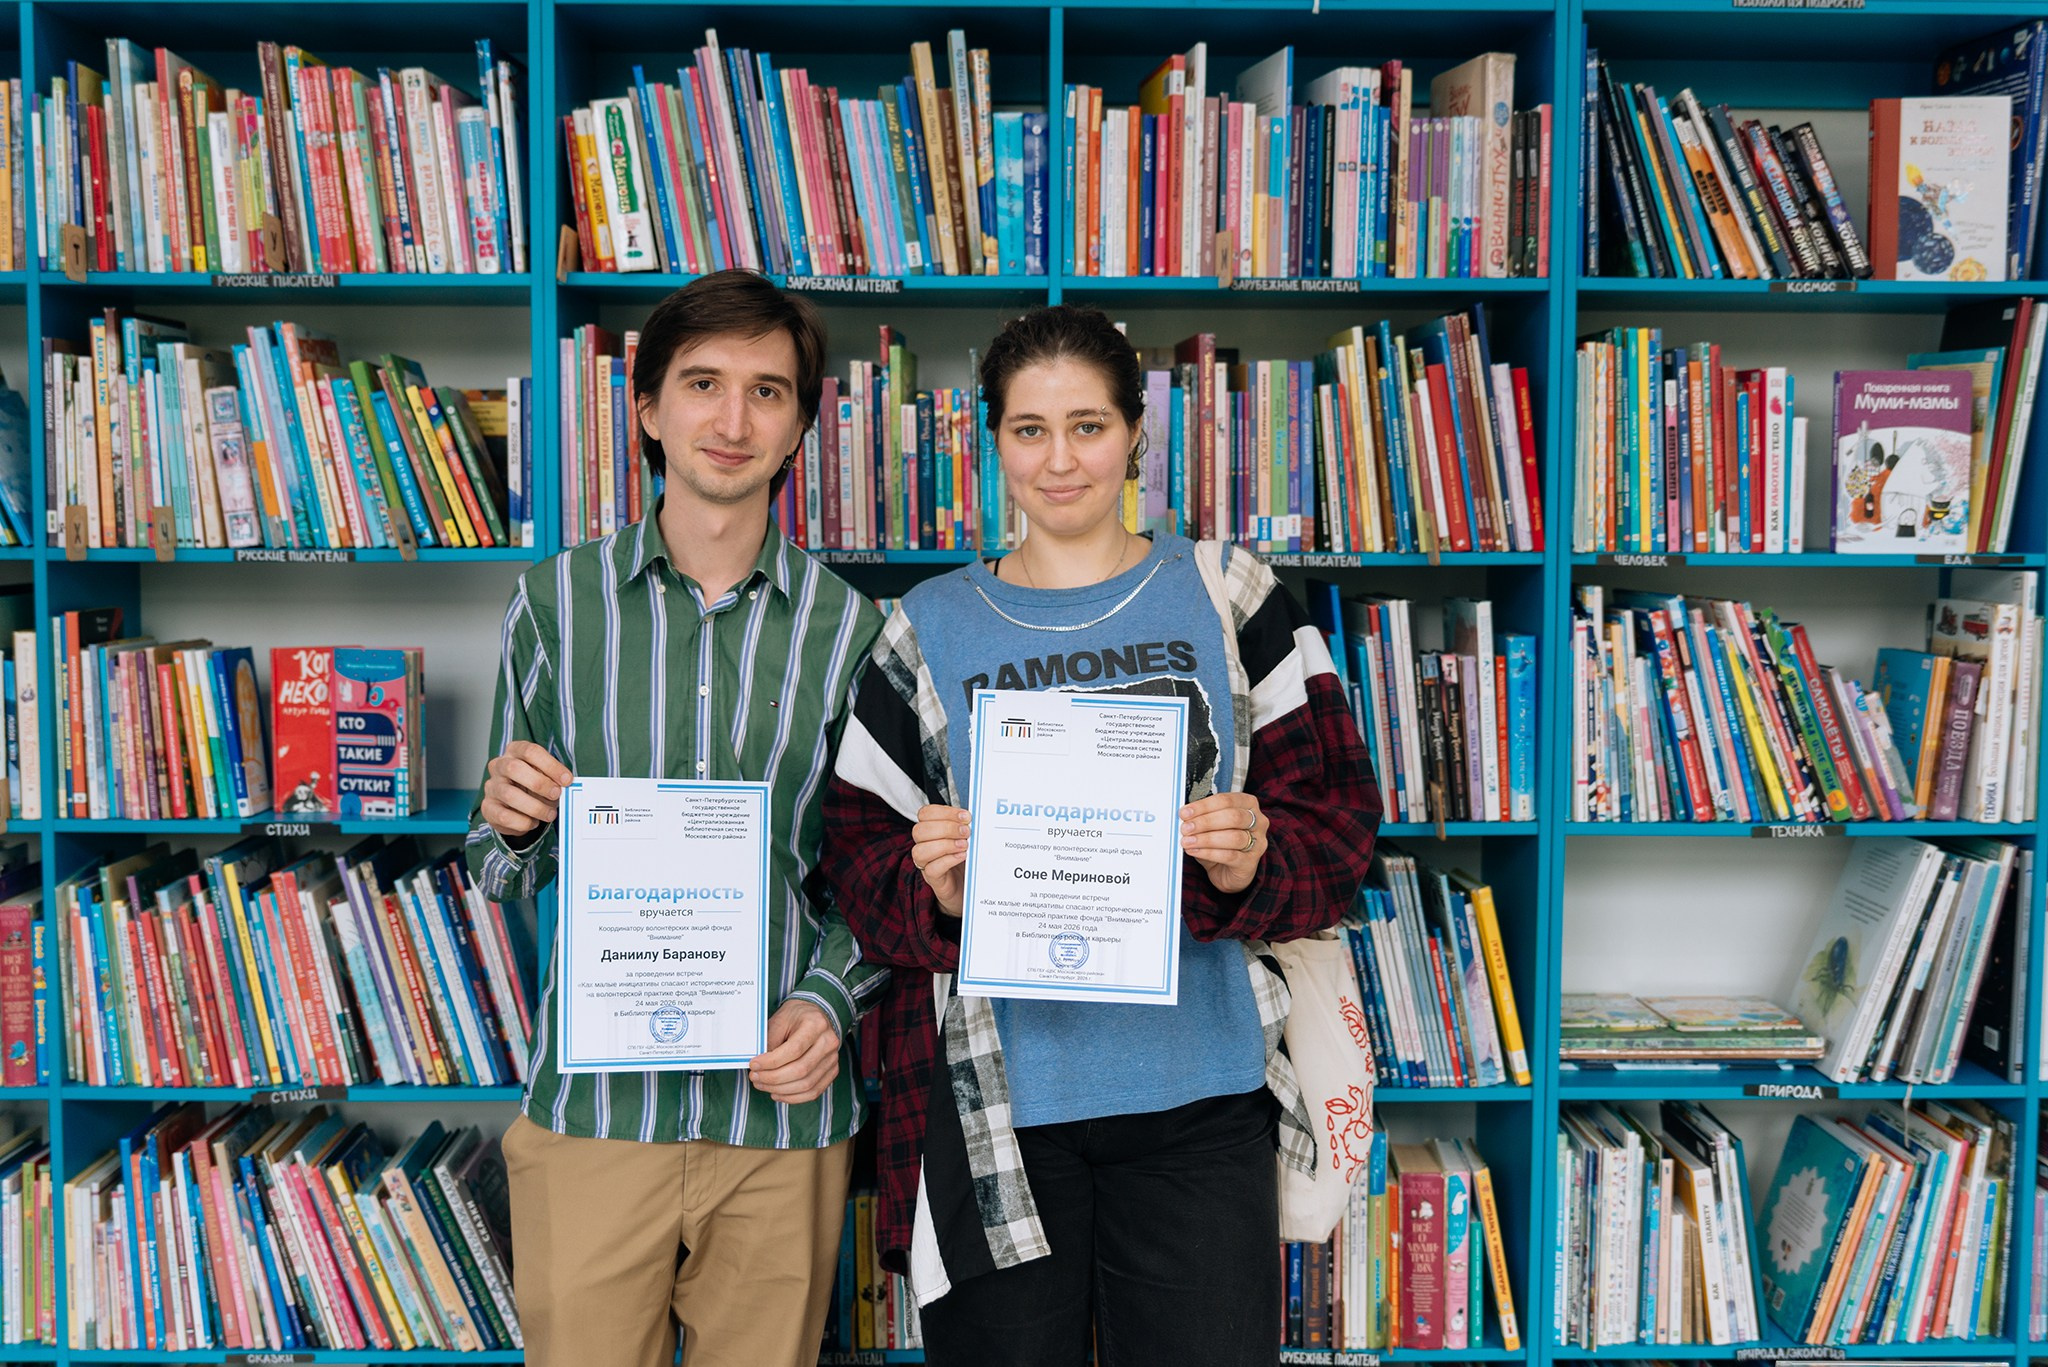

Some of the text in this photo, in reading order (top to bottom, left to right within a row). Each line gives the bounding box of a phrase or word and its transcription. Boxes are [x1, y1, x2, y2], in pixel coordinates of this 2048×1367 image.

[926, 98, 936, 116] Пэн
[928, 117, 939, 145] Питер
[934, 155, 945, 183] Барри
[420, 164, 439, 236] Успенский
[475, 162, 496, 258] ВСЕ ПОВЕСТИ
[1792, 228, 1817, 272] ХОКИНГ
[1810, 222, 1836, 268] ХОКИНГ
[1838, 222, 1863, 270] ХОКИНГ
[218, 275, 336, 288] РУССКИЕ ПИСАТЕЛИ
[786, 276, 854, 290] ЗАРУБЕЖНАЯ
[1232, 280, 1359, 292] ЗАРУБЕЖНЫЕ ПИСАТЕЛИ
[1786, 281, 1836, 293] КОСМОС
[1864, 382, 1952, 394] Поваренная книга
[1855, 394, 1959, 412] Муми-мамы
[599, 364, 610, 470] ПРИКЛЮЧЕНИЯ ЛОМТИКА
[1770, 422, 1780, 532] КАК РАБОТАЕТ ТЕЛО
[238, 550, 348, 562] РУССКИЕ ПИСАТЕЛИ
[830, 552, 886, 564] ПИСАТЕЛИ
[1304, 556, 1361, 567] ПИСАТЕЛИ
[1614, 555, 1668, 567] ЧЕЛОВЕК
[1944, 555, 1973, 566] ЕДА
[962, 640, 1198, 712] RAMONES
[339, 718, 366, 729] КТО
[1099, 713, 1163, 723] Санкт-Петербургское
[1810, 678, 1844, 758] САМОЛЁТЫ
[1106, 721, 1156, 729] государственное
[1095, 728, 1166, 738] бюджетное учреждение
[1096, 743, 1137, 751] библиотечная
[1944, 710, 1970, 774] ПОЕЗДА
[340, 748, 382, 760] ТАКИЕ
[340, 778, 392, 792] СУТКИ?
[685, 797, 748, 805] Санкт-Петербургское
[1984, 782, 1998, 820] ТЕХНИКА
[995, 798, 1156, 824] Благодарность
[266, 824, 310, 836] СТИХИ
[1047, 826, 1103, 838] вручается
[1770, 826, 1824, 838] ТЕХНИКА
[722, 833, 746, 841] района»
[1004, 842, 1051, 851] Координатору
[1099, 846, 1119, 855] акций
[1120, 848, 1142, 856] фонда
[1054, 854, 1092, 863] "Внимание"
[1014, 867, 1130, 884] Соне Мериновой
[588, 884, 744, 903] Благодарность
[1039, 892, 1081, 900] проведении
[1082, 894, 1110, 902] встречи
[640, 908, 693, 918] вручается
[1022, 902, 1064, 910] инициативы
[1096, 905, 1143, 914] исторические
[999, 911, 1046, 920] волонтерской
[1047, 914, 1078, 922] практике
[1079, 914, 1103, 923] фонда
[1092, 936, 1121, 944] карьеры
[601, 948, 726, 962] Даниилу Баранову
[270, 1087, 318, 1102] СТИХИ
[1759, 1084, 1822, 1098] ПРИРОДА
[247, 1354, 294, 1364] СКАЗКИ
[1334, 1352, 1380, 1367] ПИСАТЕЛИ
[1736, 1348, 1845, 1361] ПРИРОДА/ЭКОЛОГИЯ
